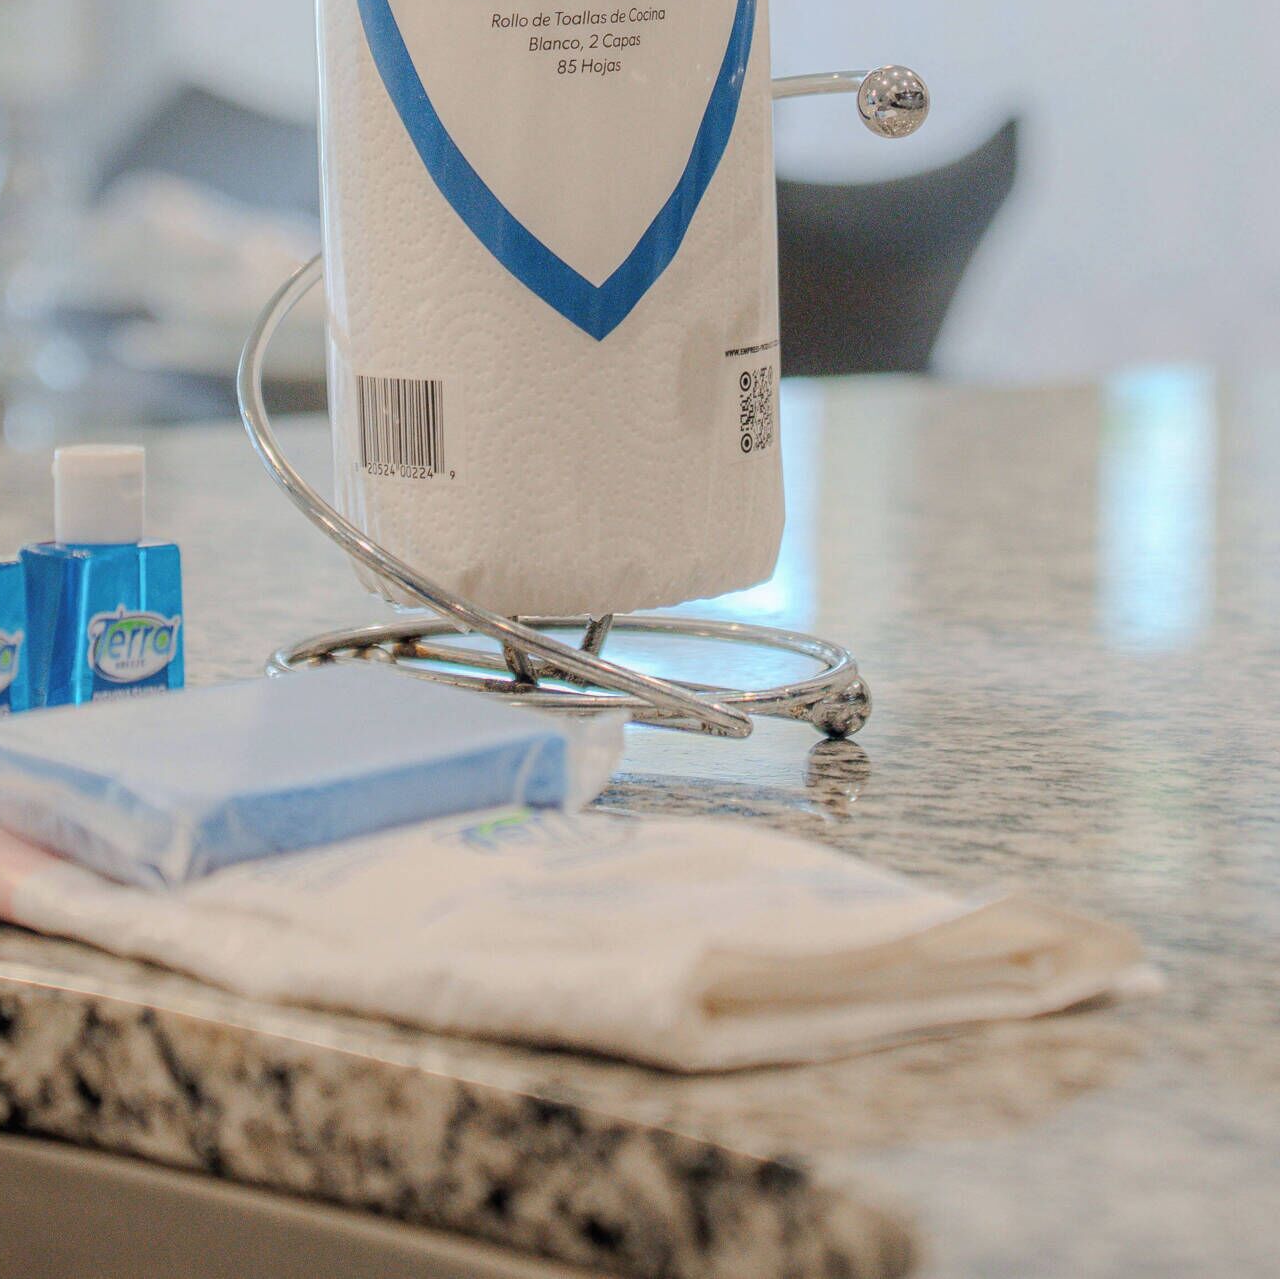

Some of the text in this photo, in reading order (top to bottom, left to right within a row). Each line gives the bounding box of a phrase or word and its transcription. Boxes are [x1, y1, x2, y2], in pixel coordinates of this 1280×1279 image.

[491, 6, 666, 29] Rollo de Toallas de Cocina
[528, 32, 641, 52] Blanco, 2 Capas
[556, 57, 623, 77] 85 Hojas
[367, 462, 395, 477] 20524
[400, 465, 434, 479] 00224
[91, 616, 174, 663] Terra
